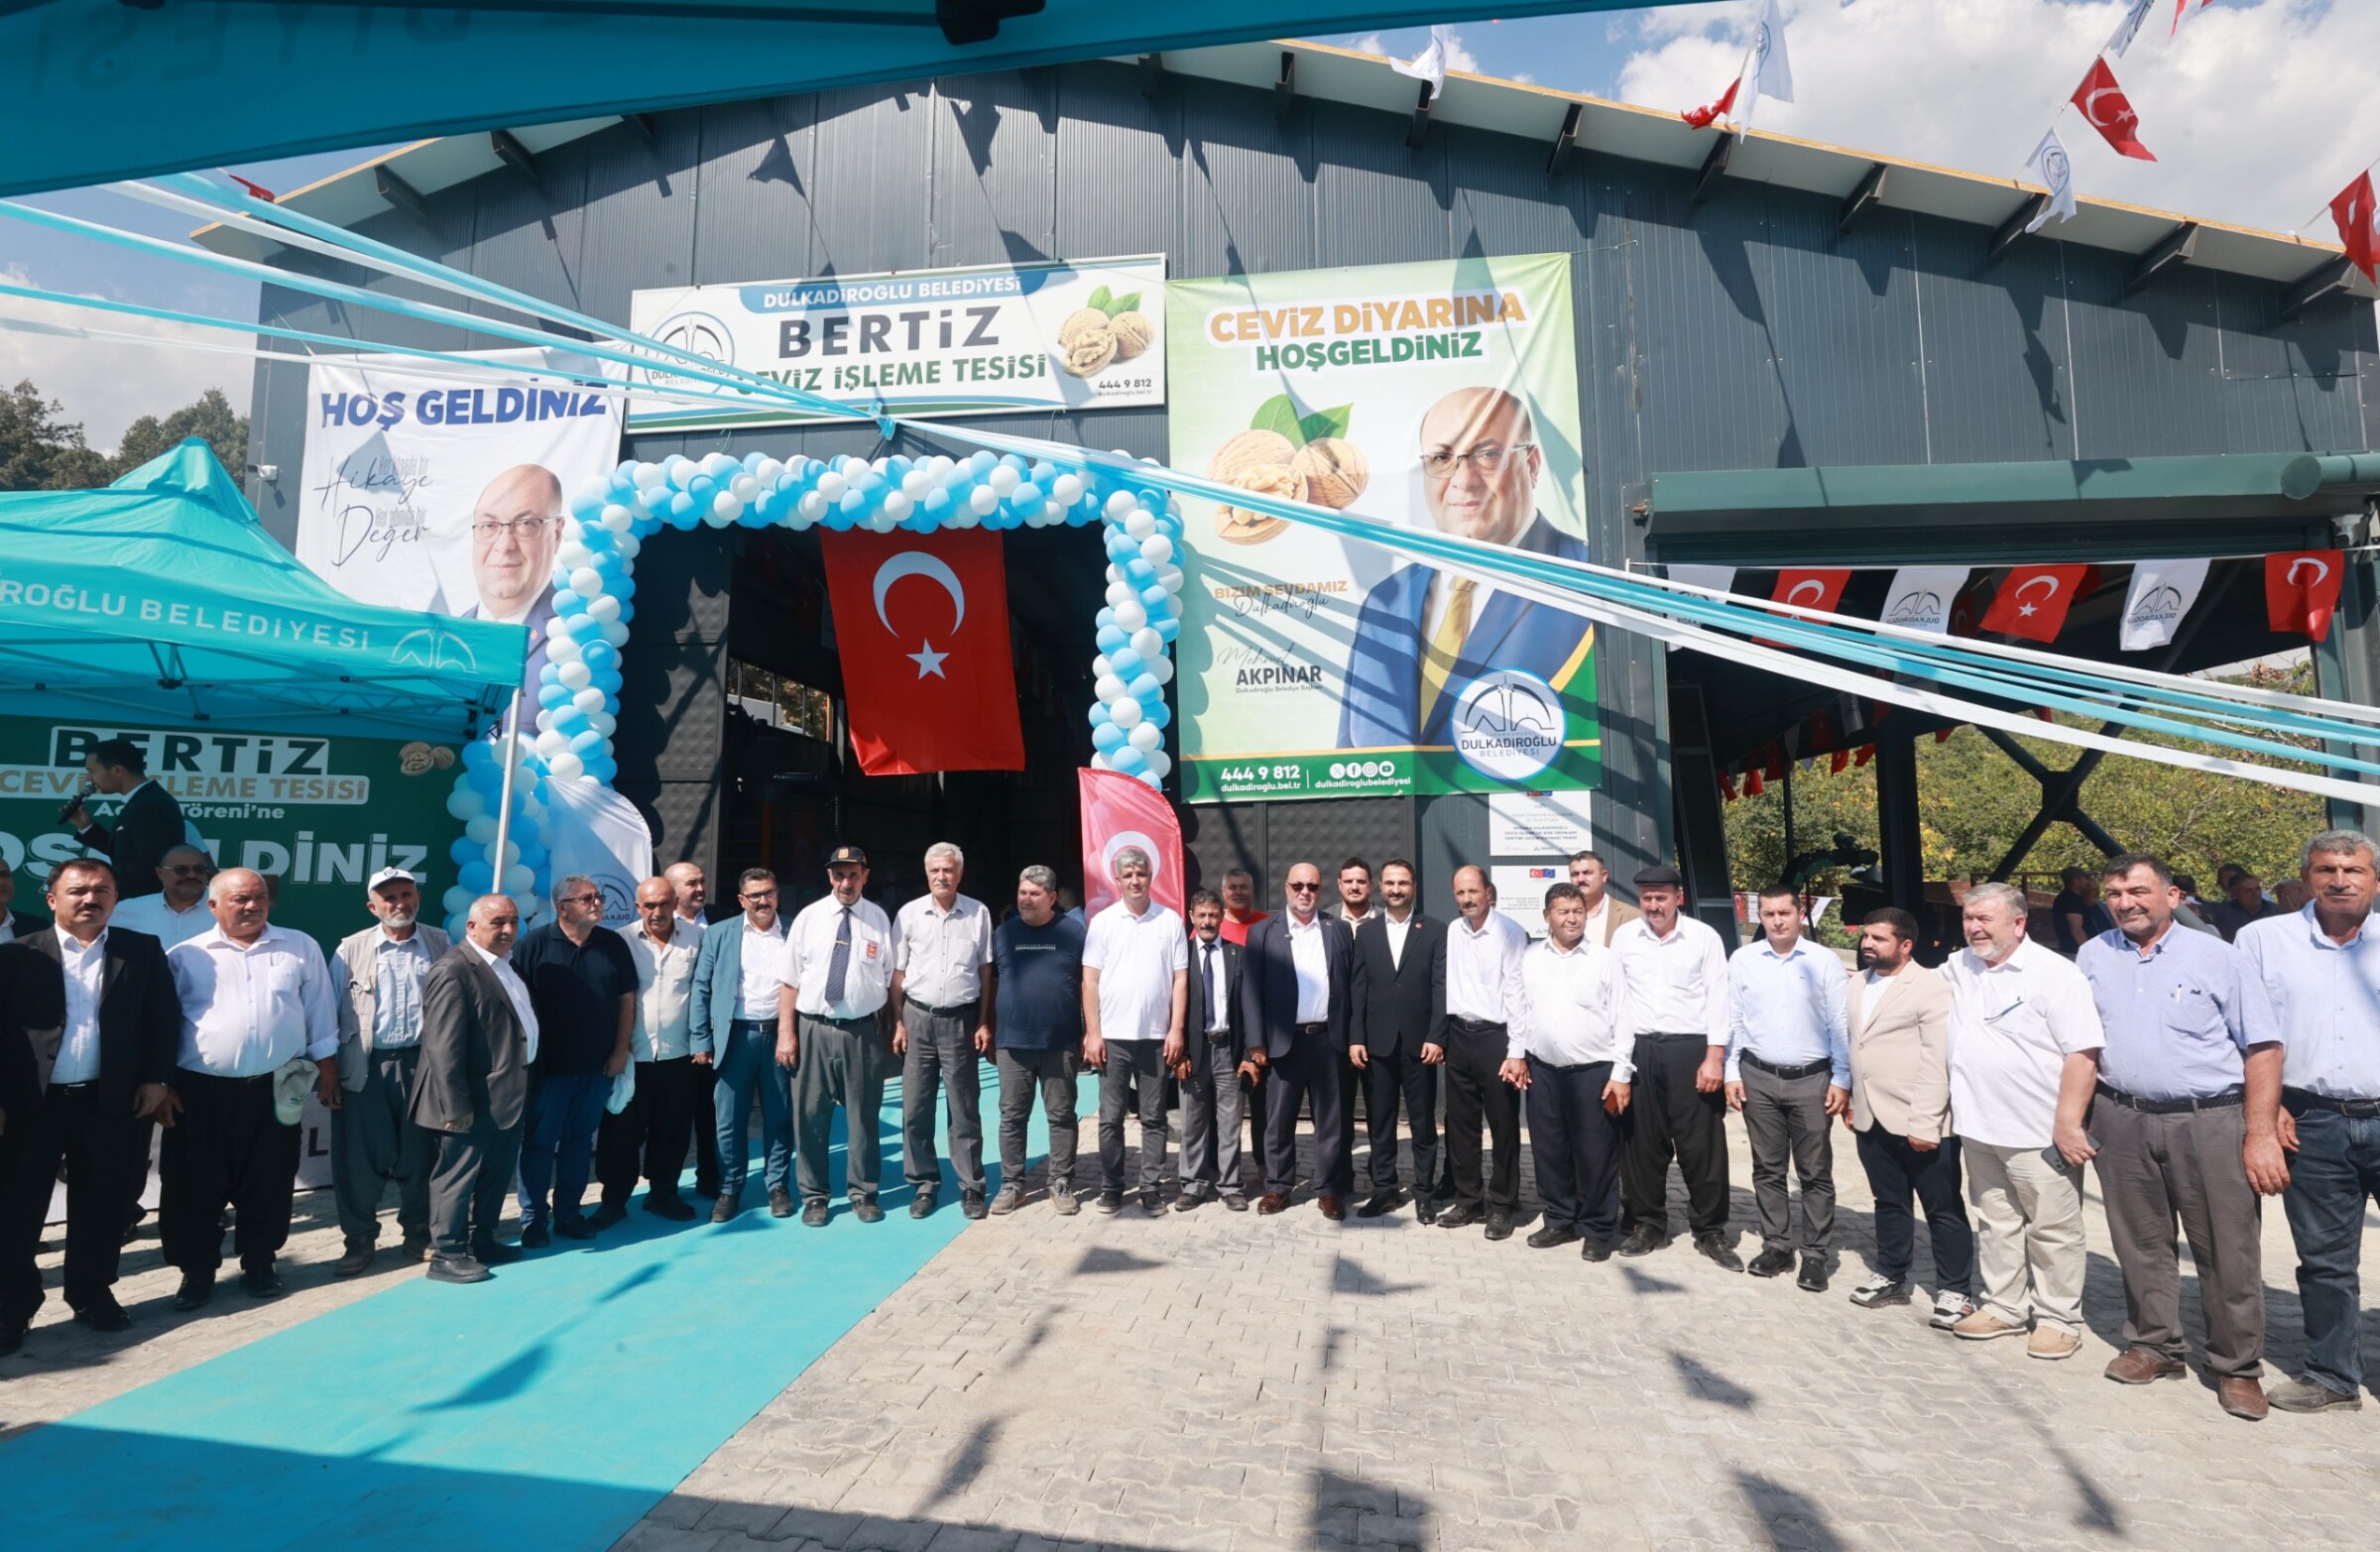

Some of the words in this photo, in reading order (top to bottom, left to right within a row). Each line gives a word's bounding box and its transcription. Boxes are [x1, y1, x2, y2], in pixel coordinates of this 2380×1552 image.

[1098, 380, 1121, 389] 444
[1124, 379, 1130, 388] 9
[1133, 378, 1152, 388] 812
[320, 391, 407, 431] HOŞ
[1236, 664, 1323, 686] AKPINAR
[55, 730, 327, 776] BRTİZ
[1221, 767, 1254, 781] 444
[1258, 766, 1269, 779] 9
[1272, 765, 1301, 779] 812
[1221, 780, 1302, 793] dulkadiroglu.bel.tr
[1315, 776, 1412, 789] dulkadiroglubelediyesi
